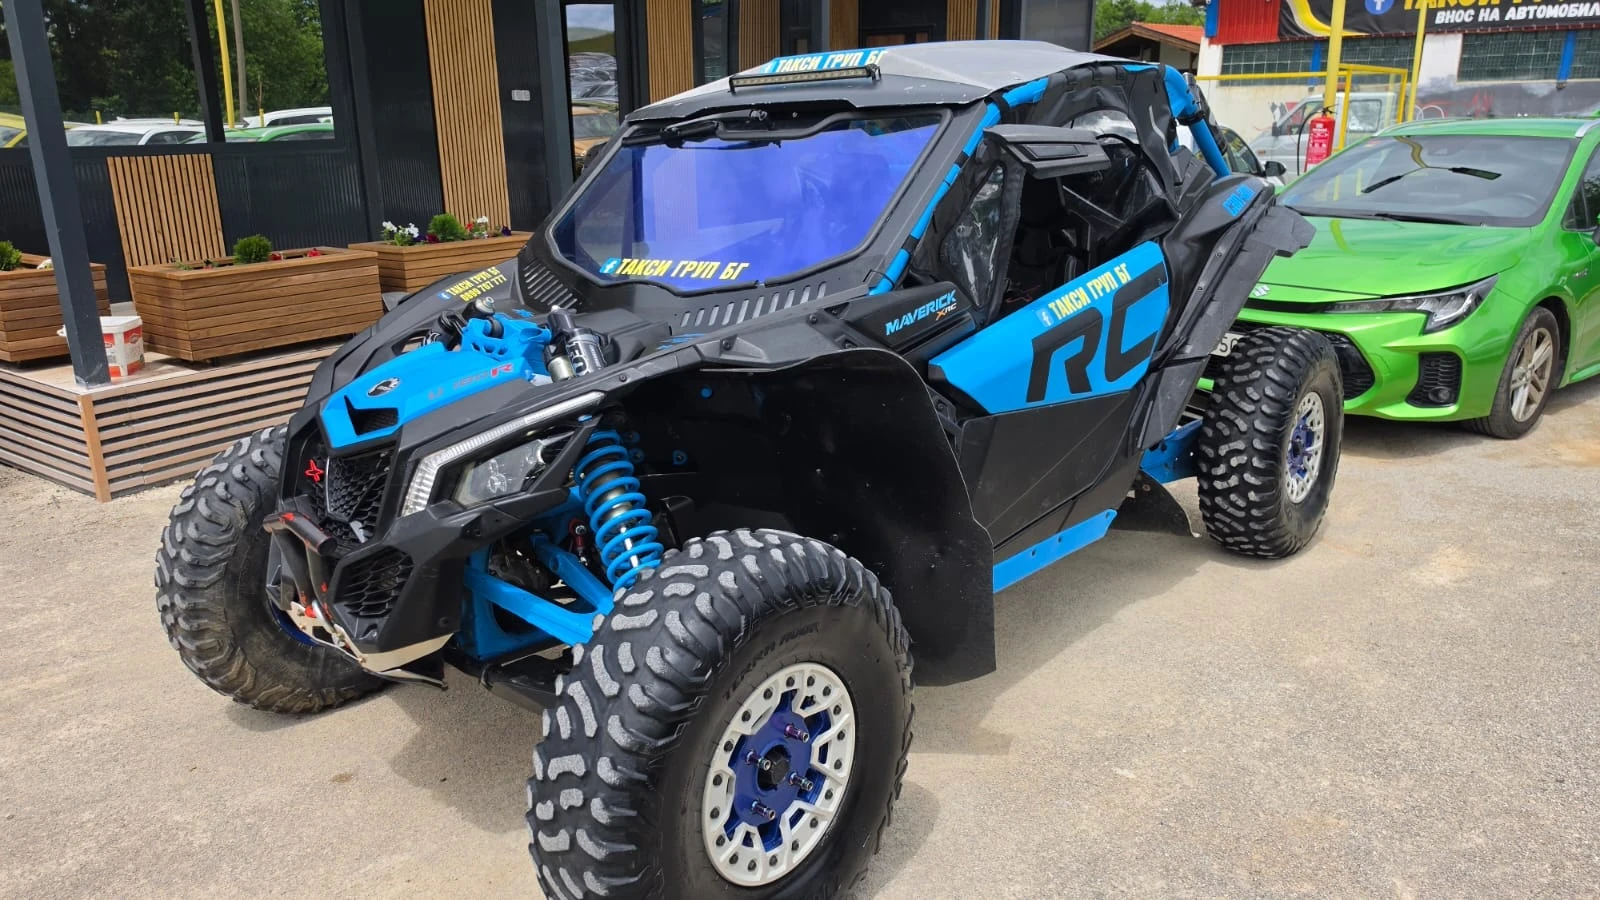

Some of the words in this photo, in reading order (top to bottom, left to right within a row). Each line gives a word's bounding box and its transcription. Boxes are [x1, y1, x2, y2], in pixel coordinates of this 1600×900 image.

[1435, 10, 1475, 24] ВНОС
[1478, 8, 1500, 21] НА
[776, 56, 823, 72] ТАКСИ
[823, 51, 865, 69] ГРУП
[616, 258, 673, 276] ТАКСИ
[671, 260, 721, 278] ГРУП
[719, 262, 750, 280] БГ
[1048, 287, 1092, 320] ТАКСИ
[1086, 271, 1119, 299] ГРУП
[1113, 263, 1132, 284] БГ
[885, 289, 957, 336] MAVERICK
[1025, 261, 1168, 403] RC
